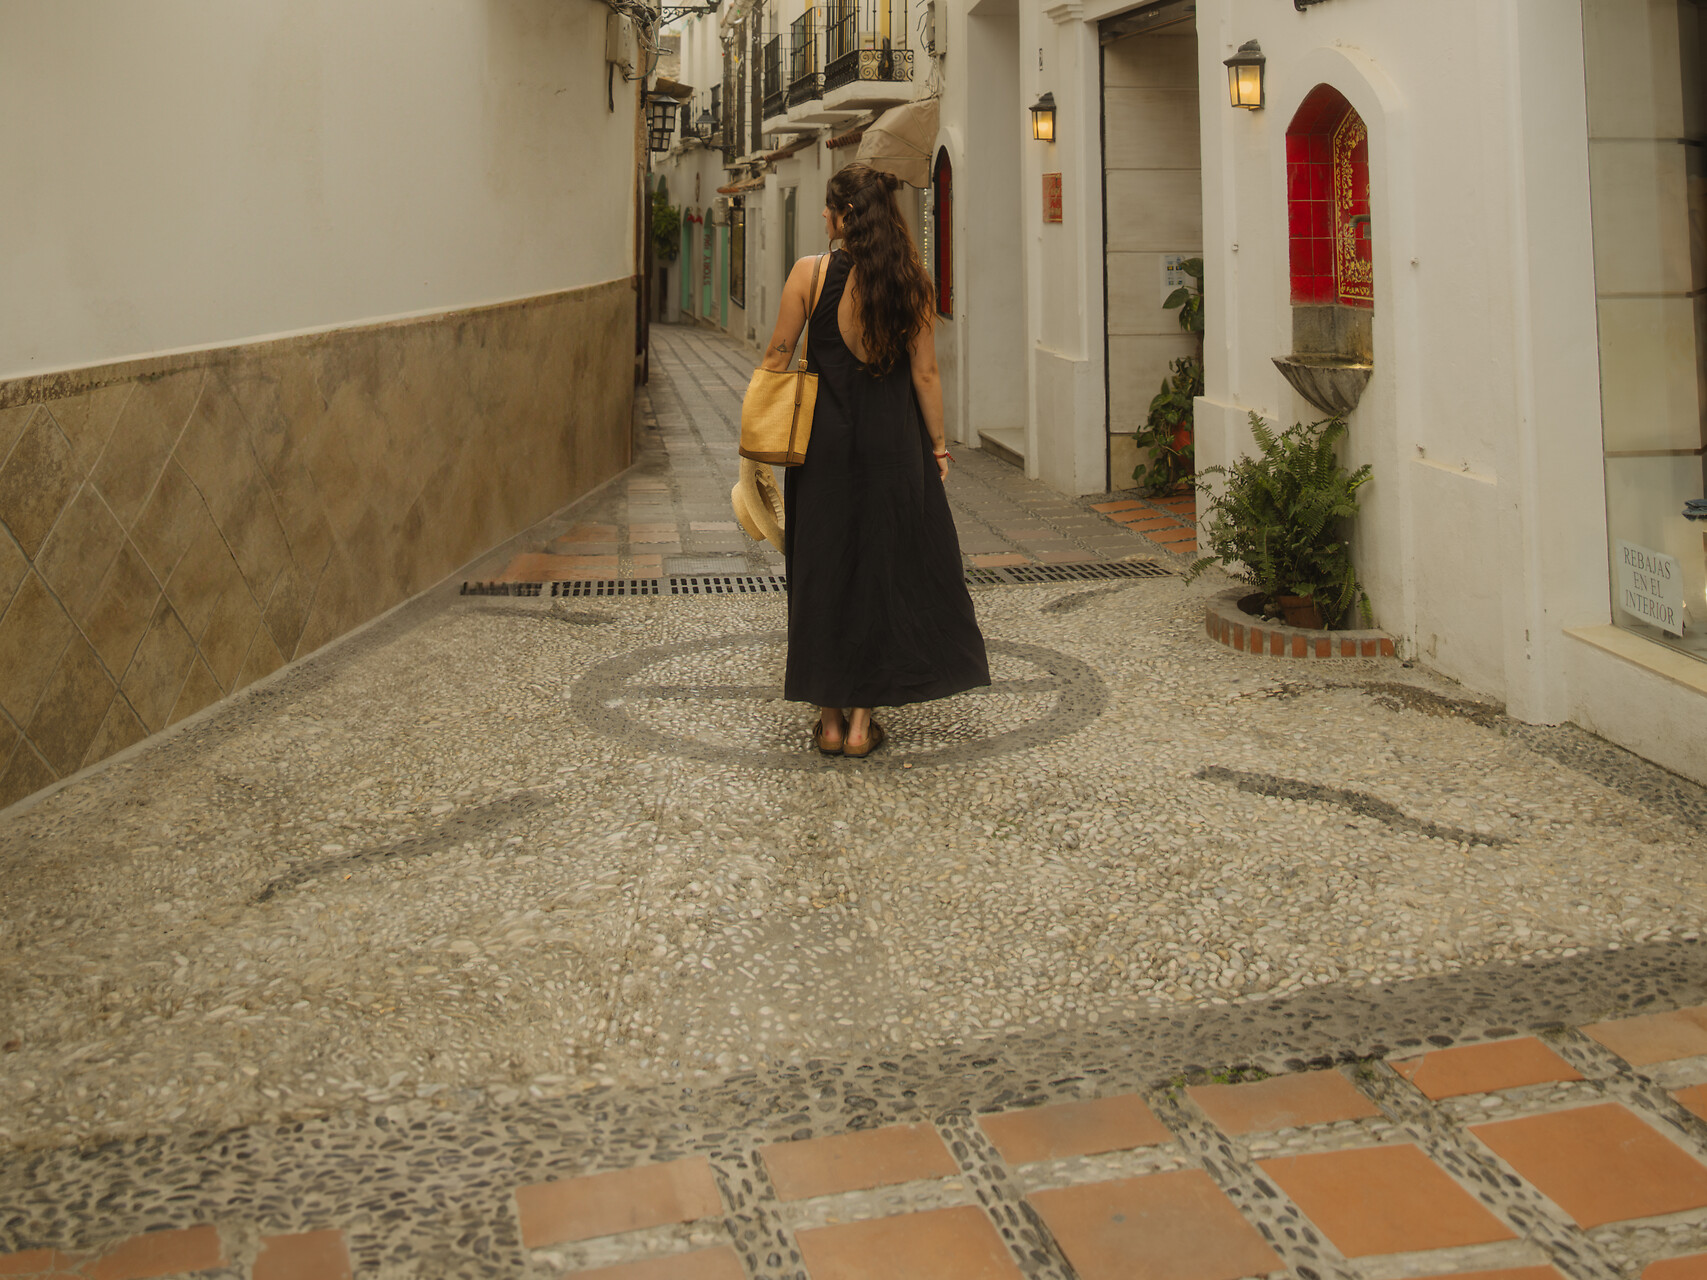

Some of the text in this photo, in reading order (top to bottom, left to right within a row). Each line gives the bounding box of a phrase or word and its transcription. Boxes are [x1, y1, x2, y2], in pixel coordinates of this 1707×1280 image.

[1623, 546, 1671, 580] REBAJAS
[1633, 571, 1664, 599] EN EL
[1625, 589, 1675, 626] INTERIOR
